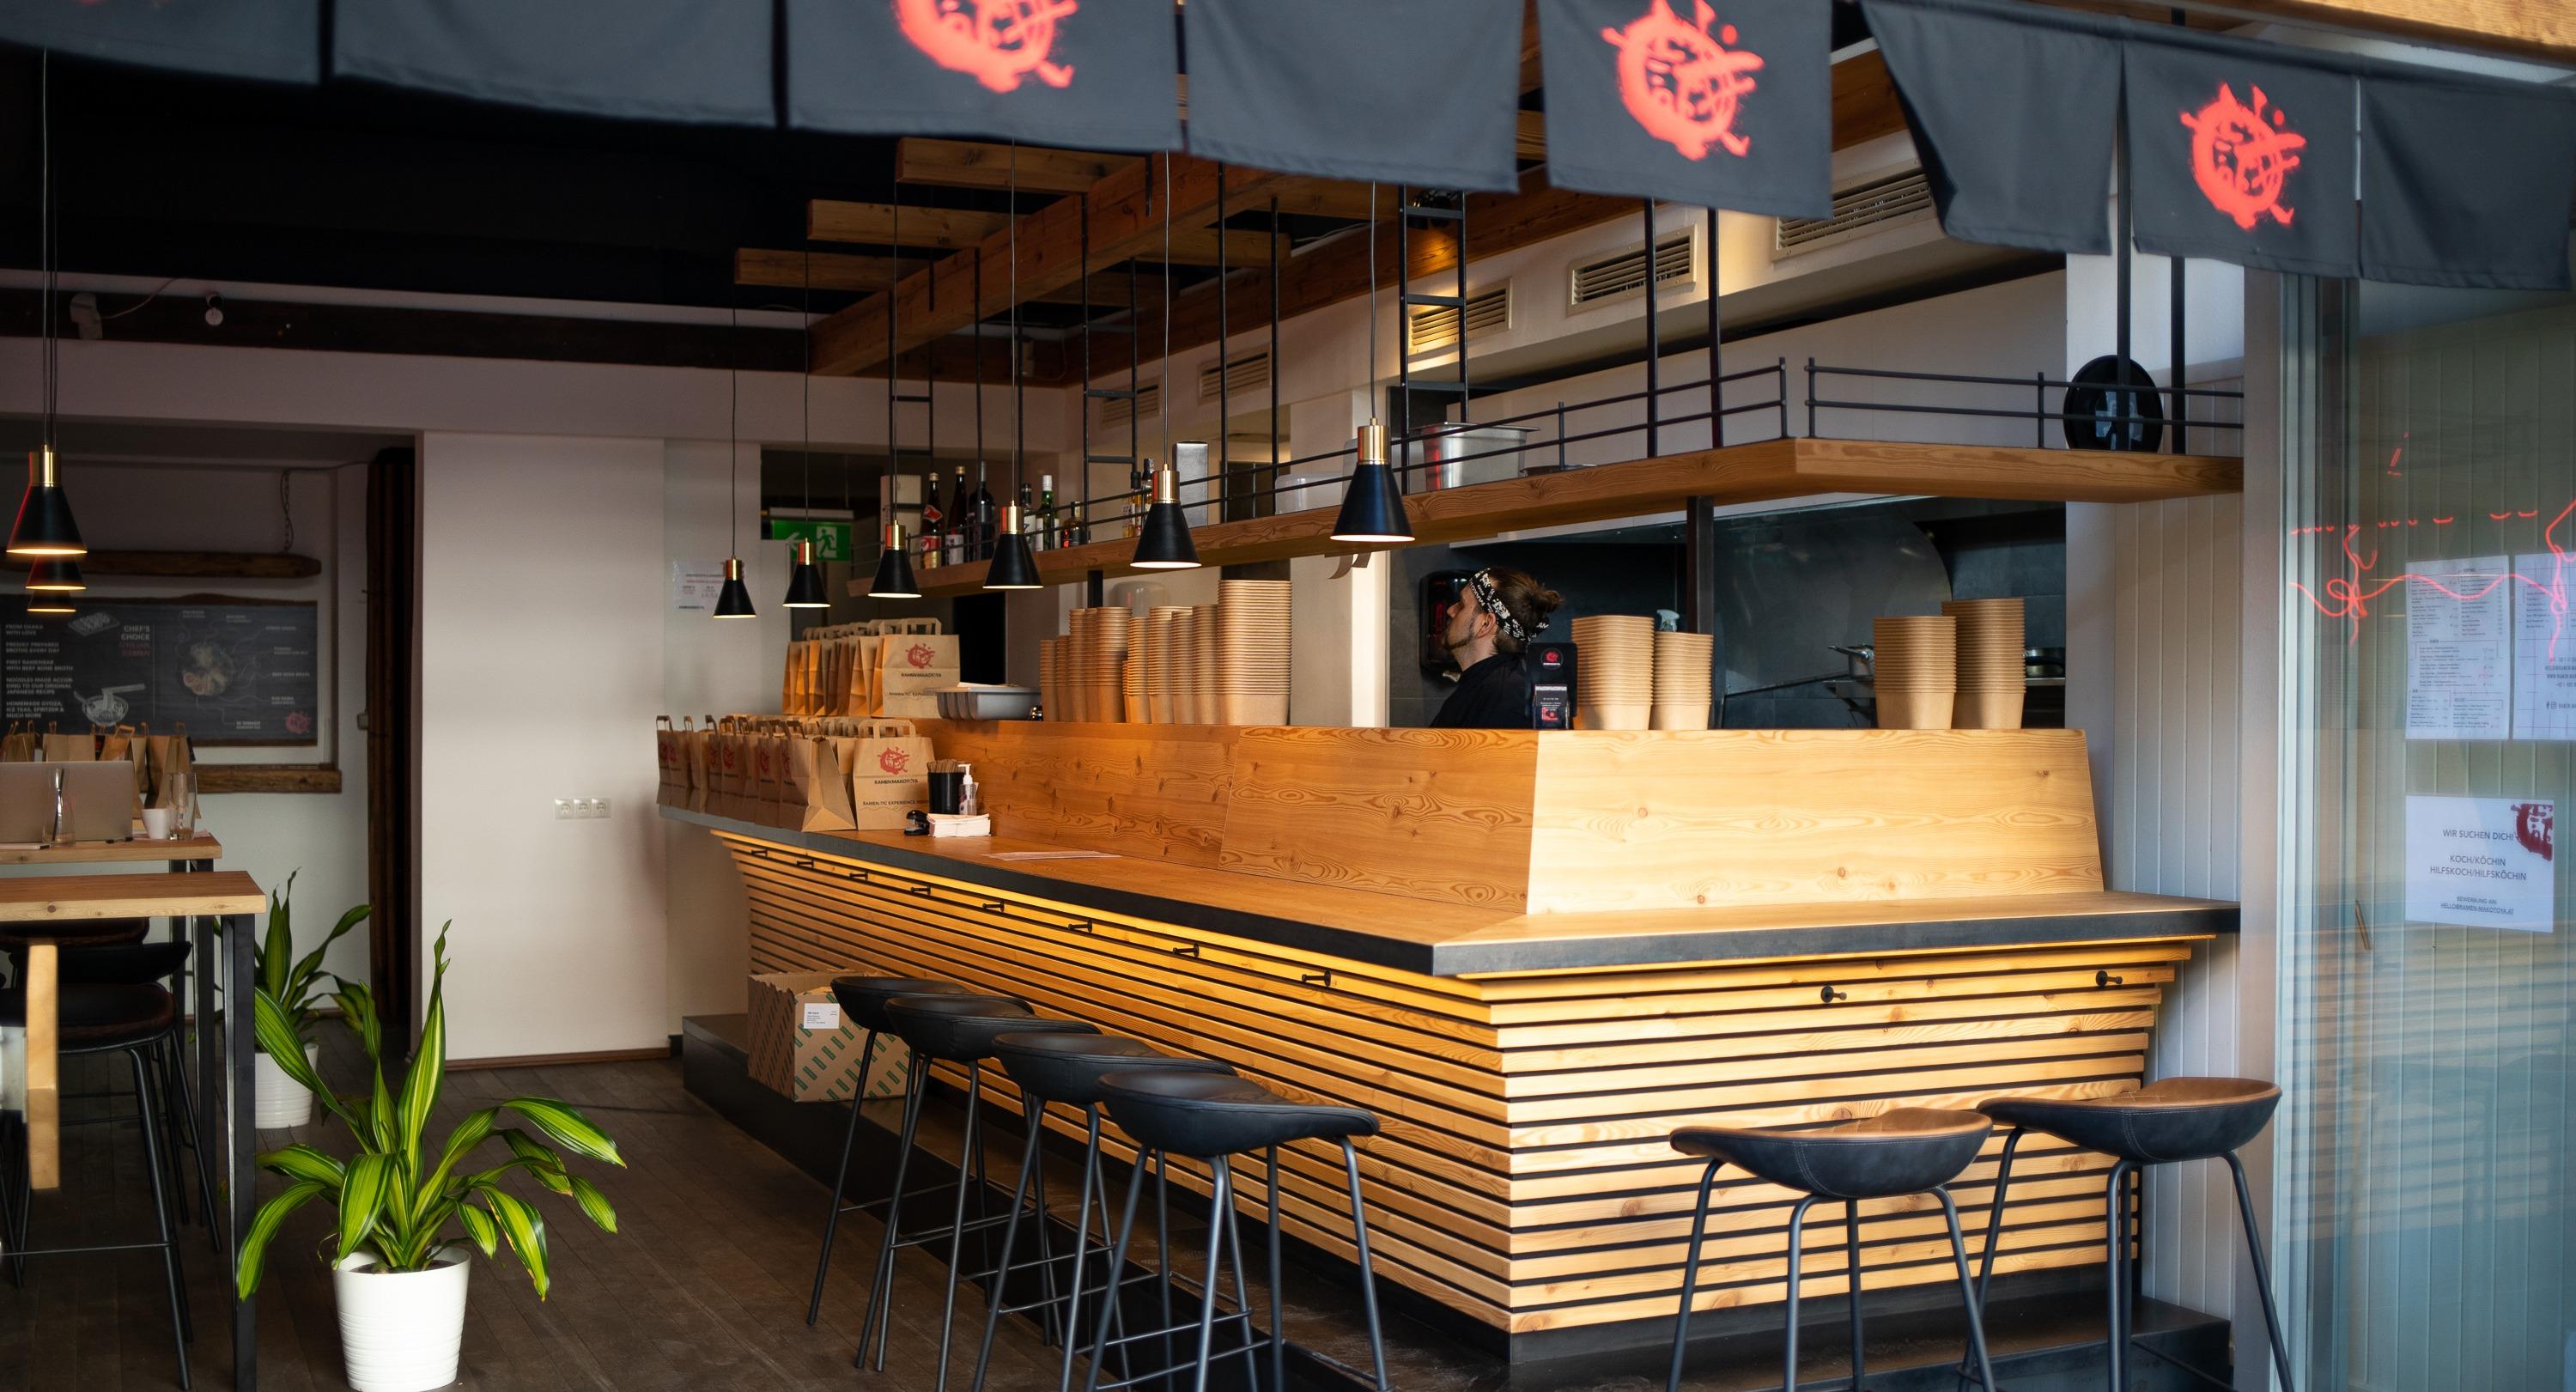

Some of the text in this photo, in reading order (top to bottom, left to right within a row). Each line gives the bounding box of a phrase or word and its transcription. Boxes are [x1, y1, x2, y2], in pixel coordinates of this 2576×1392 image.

[2442, 830, 2514, 841] WIR SUCHEN DICH!
[2450, 854, 2506, 866] KOCH/KÖCHIN
[2430, 866, 2527, 881] HILFSKOCH/HILFSKÖCHIN
